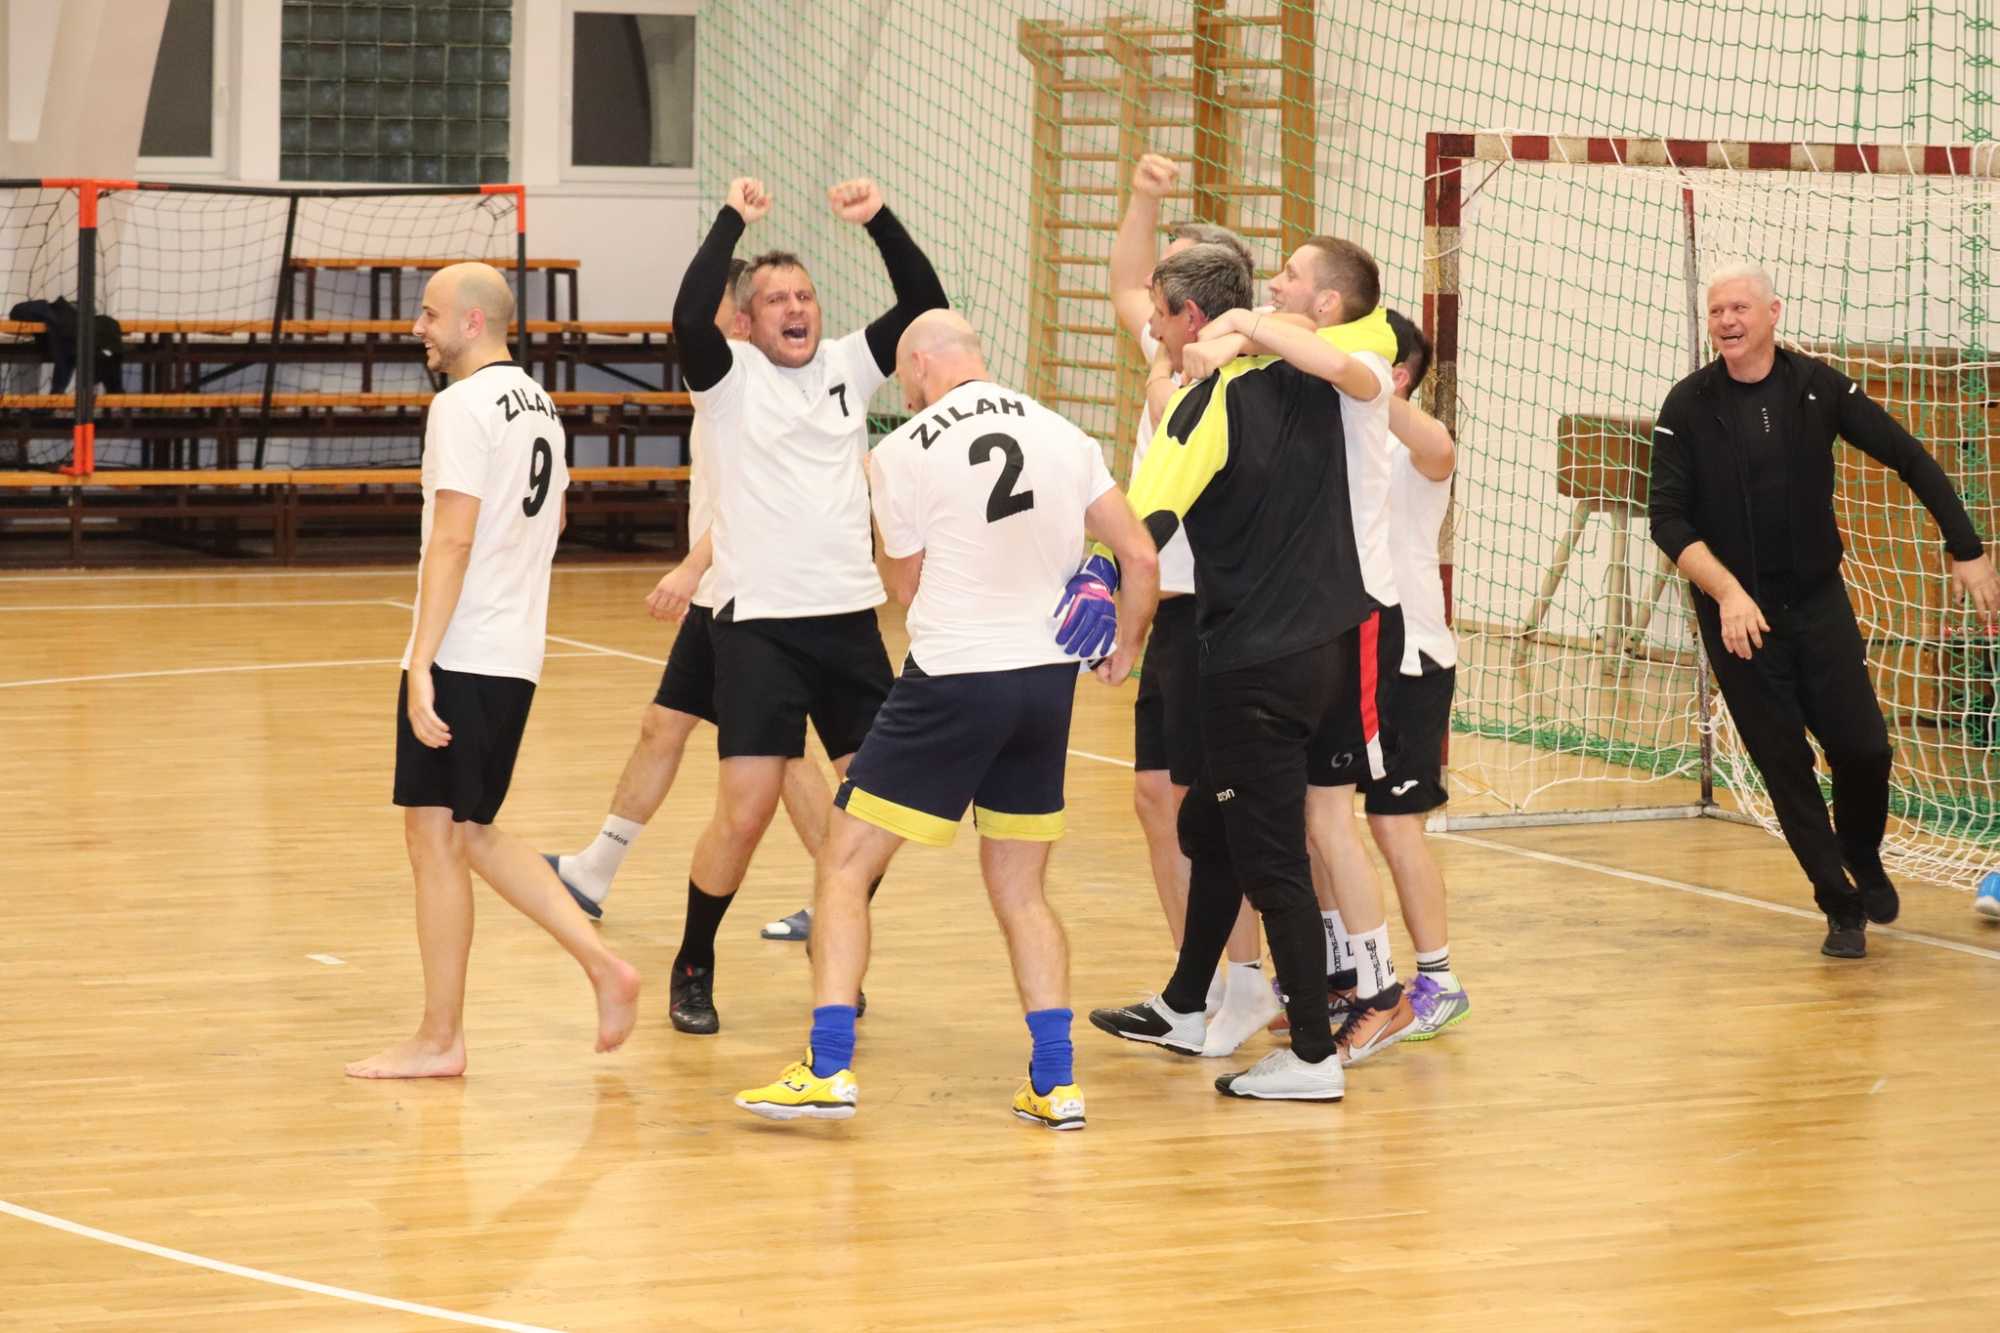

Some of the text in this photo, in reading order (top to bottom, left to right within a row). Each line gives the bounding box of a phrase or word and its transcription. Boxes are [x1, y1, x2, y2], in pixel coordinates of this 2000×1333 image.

[829, 383, 849, 417] 7
[910, 397, 1026, 450] ZILAH
[522, 437, 552, 518] 9
[968, 432, 1035, 524] 2
